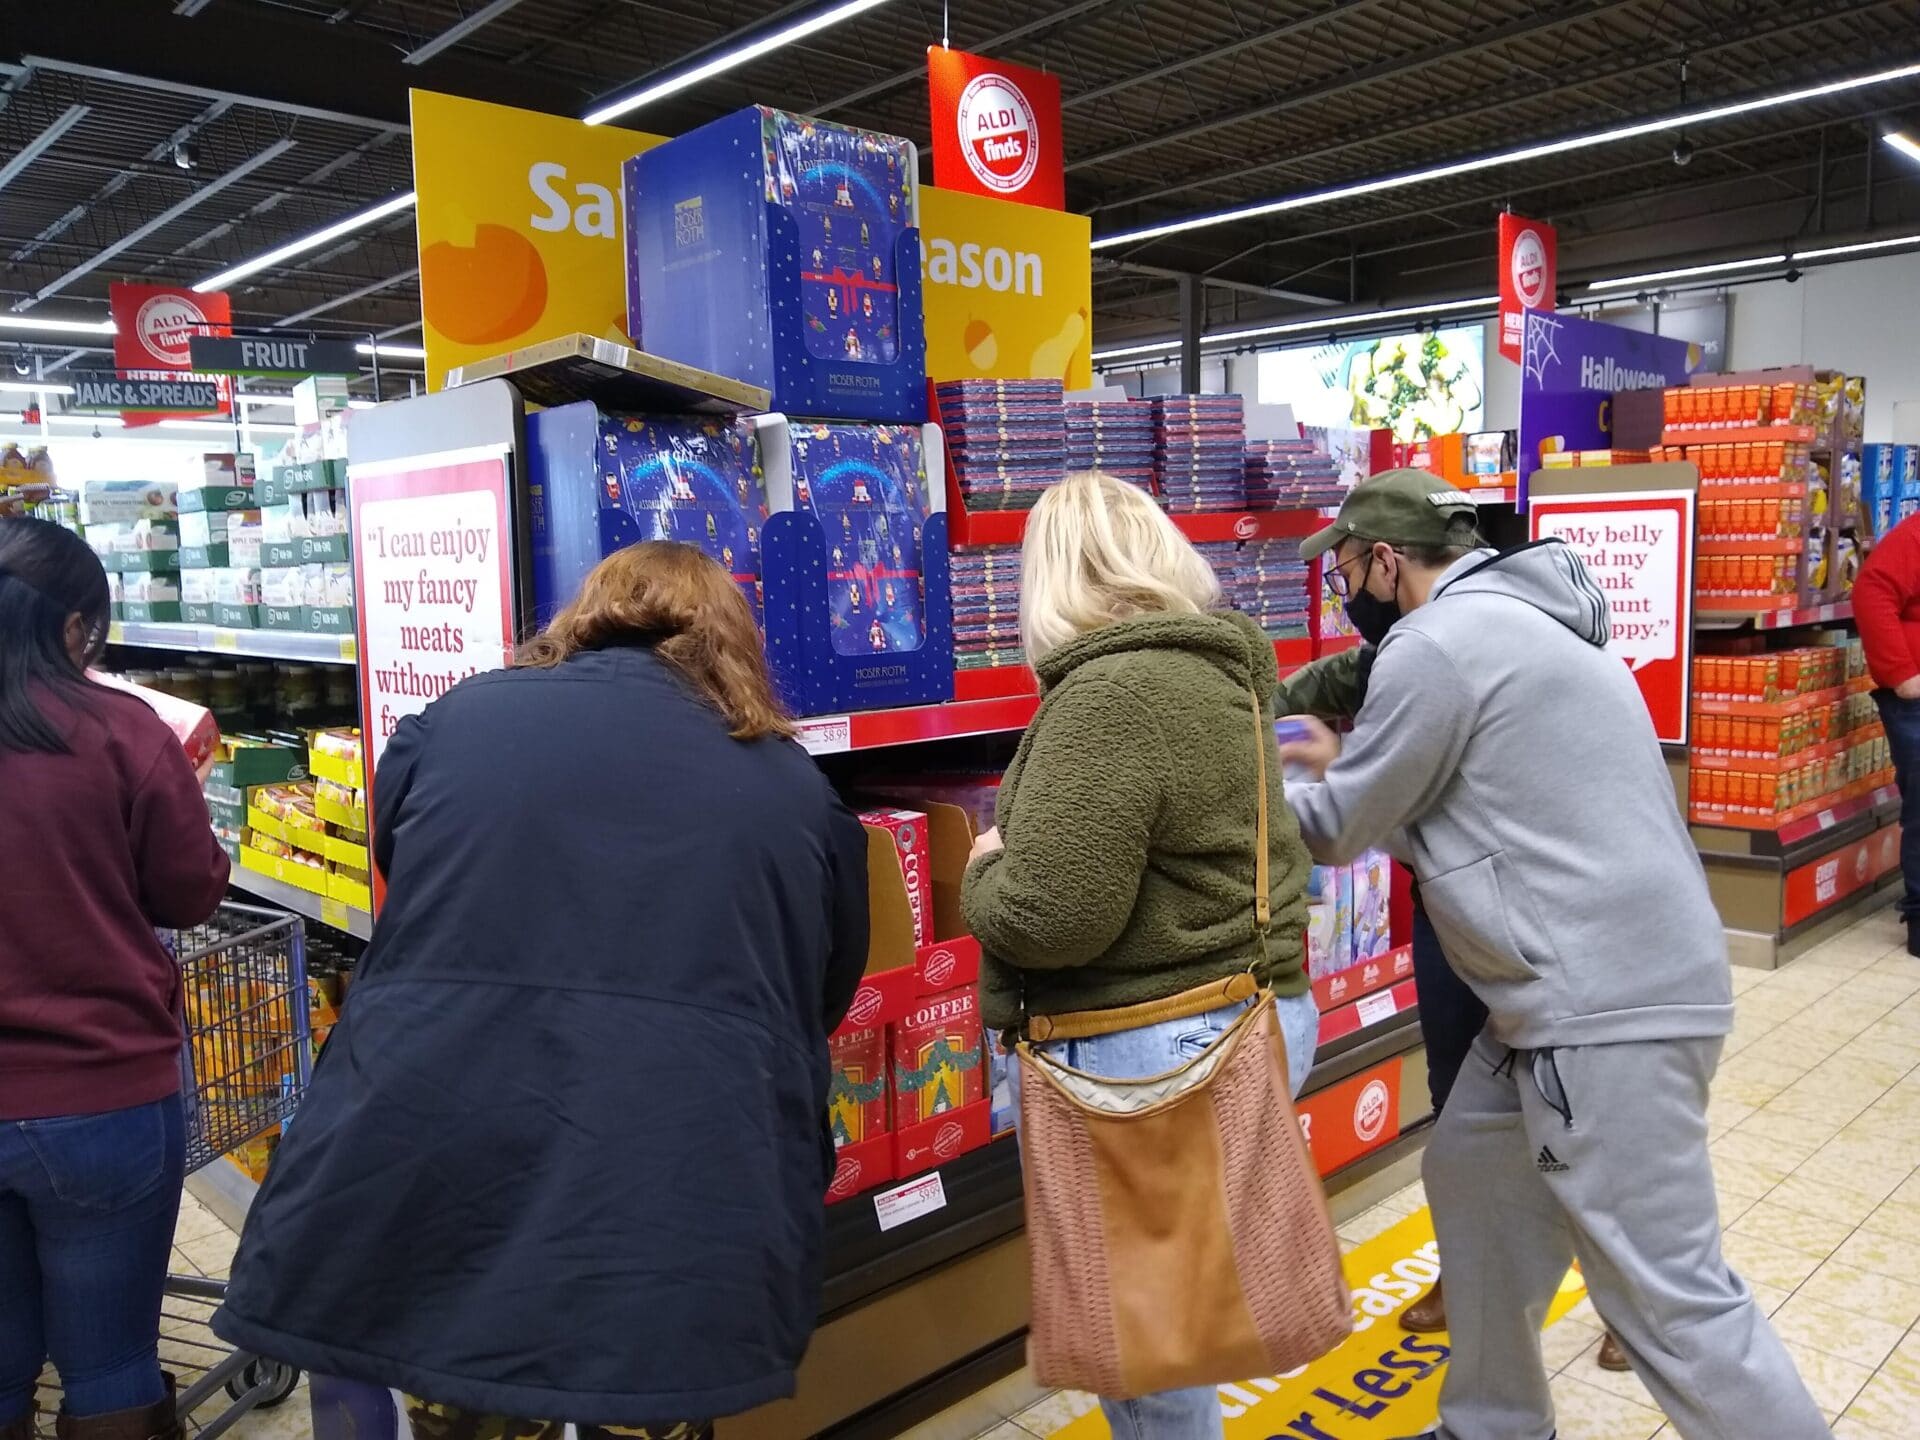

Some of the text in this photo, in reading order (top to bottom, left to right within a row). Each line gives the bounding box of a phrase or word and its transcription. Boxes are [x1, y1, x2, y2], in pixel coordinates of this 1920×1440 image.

[978, 108, 1017, 131] ALDI
[983, 136, 1023, 162] finds
[528, 162, 625, 240] Sa
[1521, 252, 1538, 269] ALDI
[152, 314, 188, 329] ALDI
[241, 341, 309, 369] FRUIT
[1581, 355, 1667, 392] Halloween
[75, 382, 123, 406] JAMS
[124, 384, 139, 405] &
[140, 384, 216, 406] SPREADS
[391, 531, 425, 557] can
[431, 518, 491, 563] enjoy
[1605, 524, 1663, 546] belly
[1613, 553, 1648, 570] my
[384, 569, 478, 613] my fancy
[1612, 598, 1652, 613] unt
[401, 622, 464, 654] meats
[1612, 618, 1670, 640] ppy.”
[375, 660, 456, 699] without
[882, 665, 906, 677] ROTH
[381, 704, 400, 736] fa
[823, 728, 848, 743] $8.99
[904, 995, 973, 1028] COFFEE
[1362, 1093, 1380, 1116] ALDI
[918, 1183, 941, 1203] $9.99
[1311, 1334, 1451, 1421] Less
